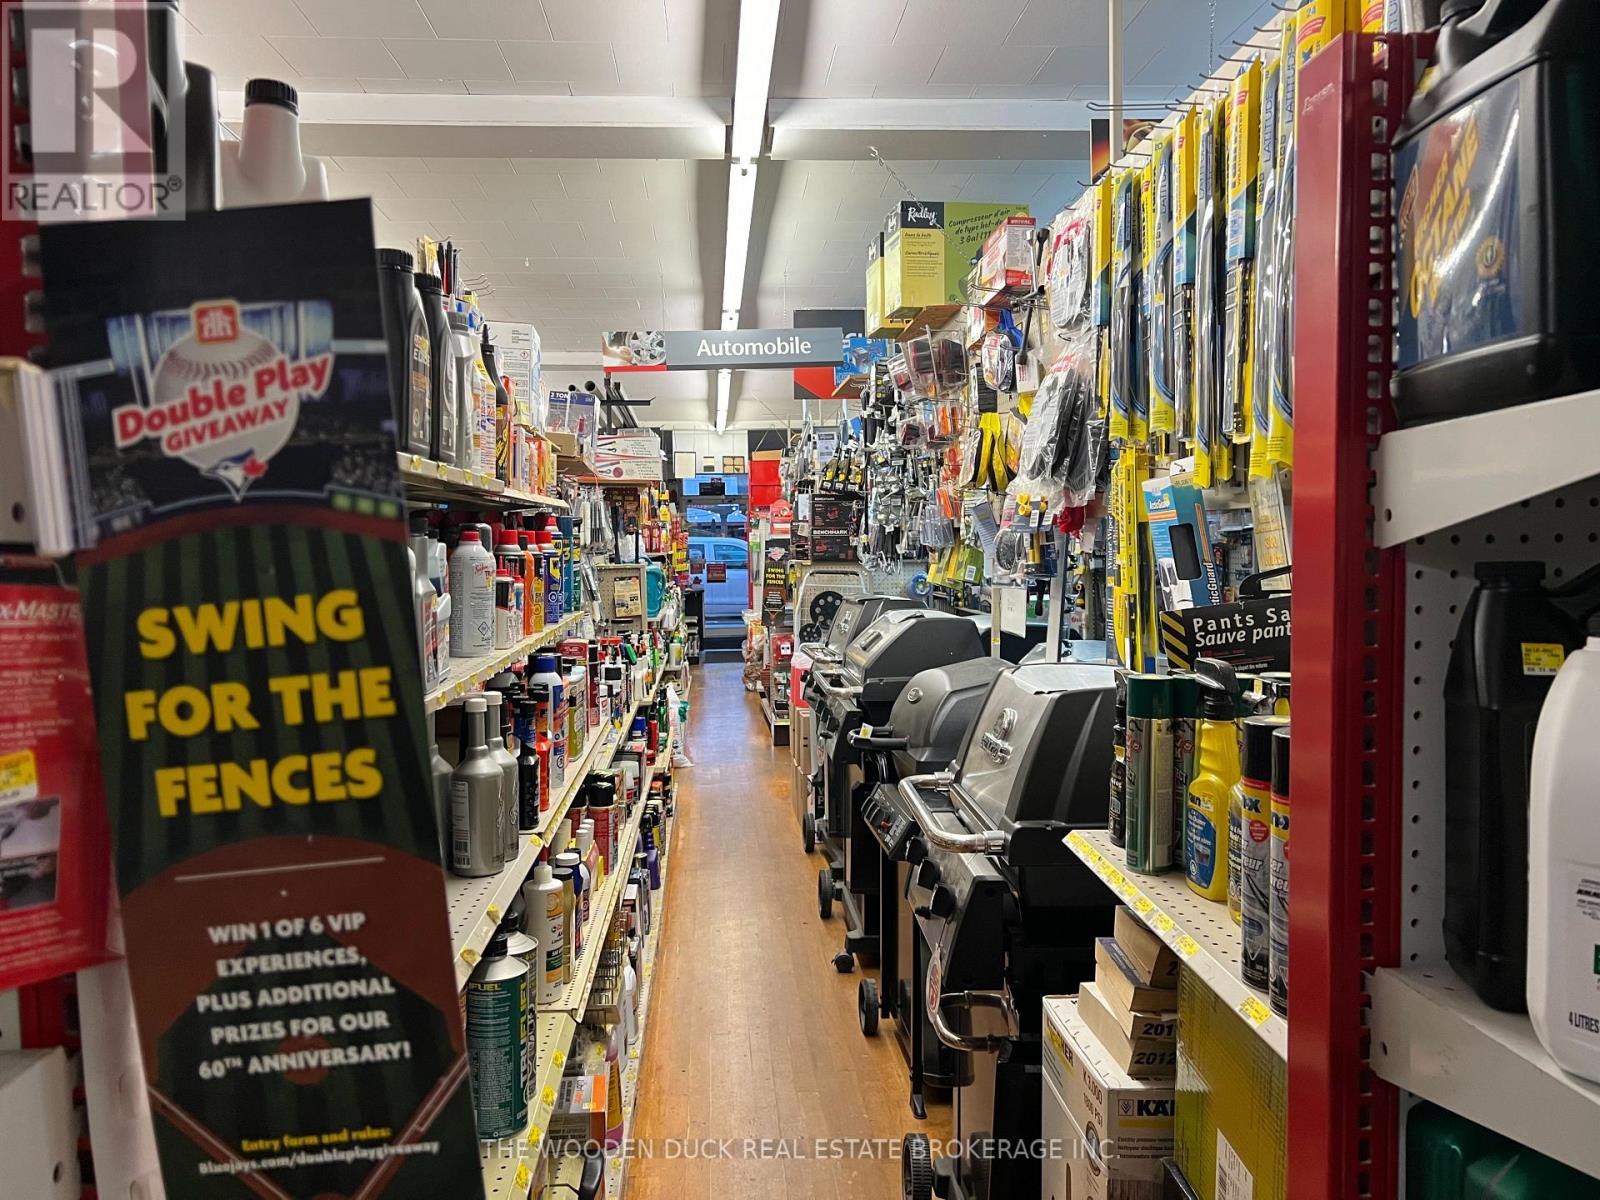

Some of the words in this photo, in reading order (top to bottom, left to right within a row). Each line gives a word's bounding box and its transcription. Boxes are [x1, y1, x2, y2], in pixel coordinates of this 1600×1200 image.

[907, 206, 937, 226] Radley
[949, 213, 993, 228] Compresseur
[967, 233, 979, 243] Gal
[697, 336, 812, 357] Automobile
[116, 378, 247, 441] Double
[255, 357, 330, 399] Play
[165, 399, 288, 452] GIVEAWAY
[137, 589, 365, 659] SWING
[1193, 614, 1254, 633] Pants
[1266, 608, 1291, 623] Sa
[1195, 630, 1246, 647] Sauve
[1252, 622, 1292, 644] pant
[125, 683, 259, 740] FOR
[269, 667, 397, 727] THE
[155, 748, 384, 817] FENCES
[208, 920, 256, 945] WIN
[260, 920, 270, 940] 1
[275, 917, 304, 938] OF
[309, 915, 324, 935] 6
[326, 912, 366, 933] VIP
[216, 946, 368, 977] EXPERIENCES,
[197, 990, 251, 1013] PLUS
[258, 976, 395, 1007] ADDITIONAL
[211, 1019, 285, 1045] PRIZES
[290, 1016, 333, 1038] FOR
[340, 1010, 390, 1031] OUR
[1568, 1011, 1574, 1026] 4
[1574, 1012, 1600, 1034] LITRES
[248, 1041, 412, 1075] ANNIVERSARY!
[1134, 1052, 1176, 1065] 2012
[241, 1139, 280, 1152] Entry
[322, 1129, 348, 1142] and
